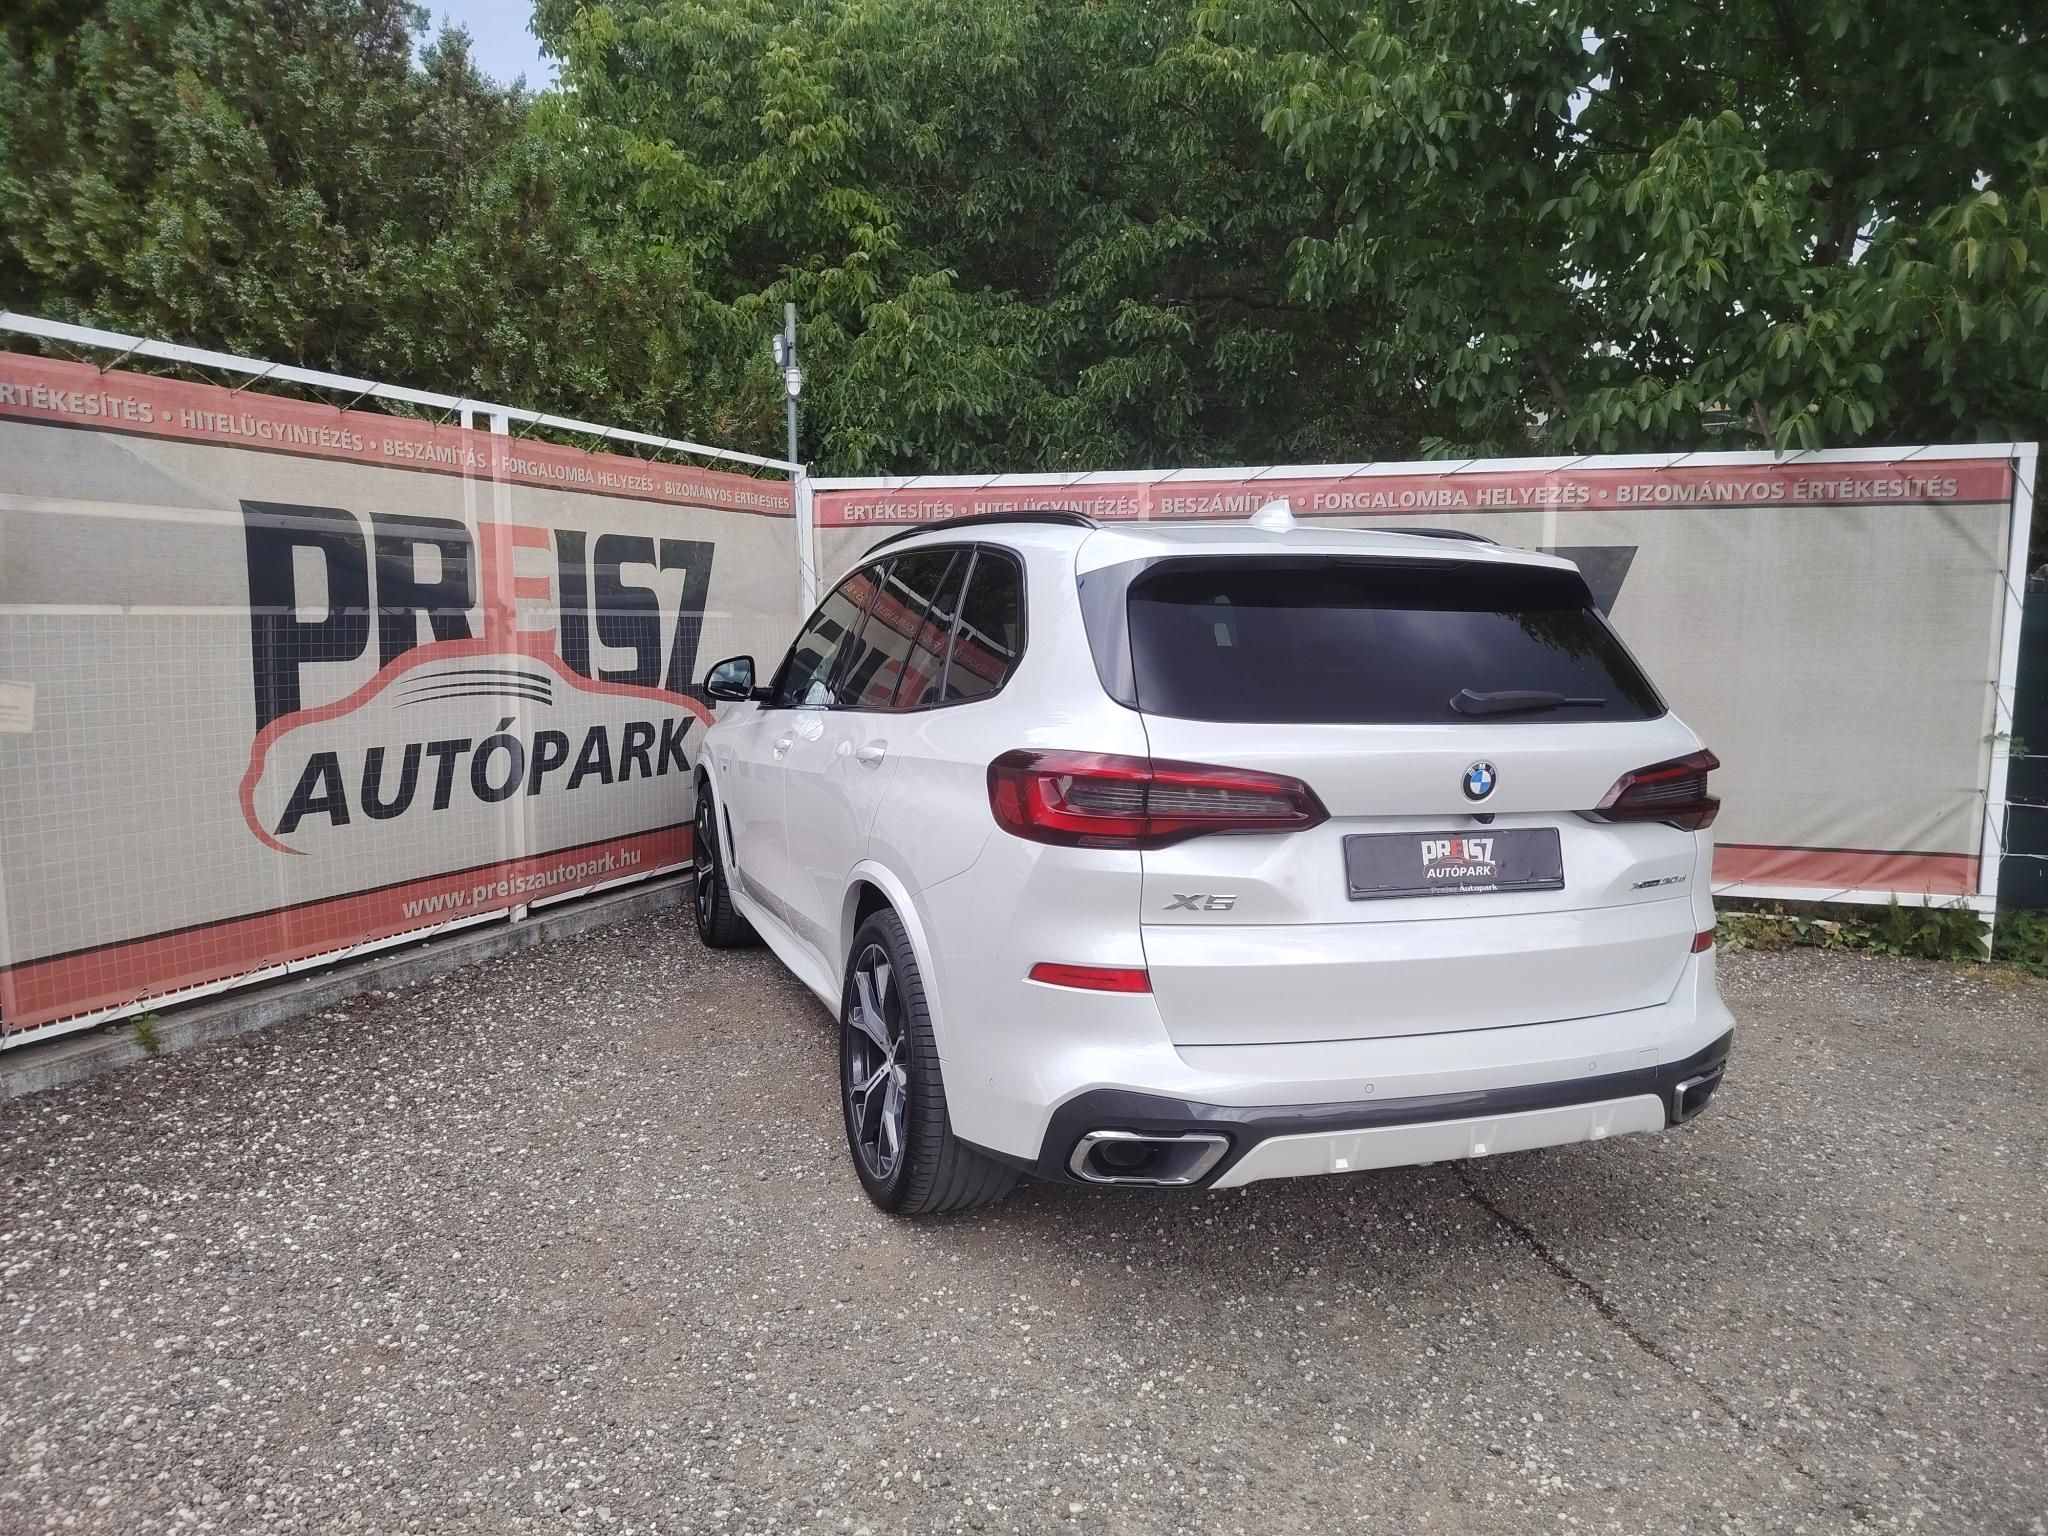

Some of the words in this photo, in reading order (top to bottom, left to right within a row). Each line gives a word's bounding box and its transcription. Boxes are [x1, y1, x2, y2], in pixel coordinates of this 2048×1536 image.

[180, 408, 364, 452] HITELÜGYINTÉZÉS
[383, 438, 487, 469] BESZÁMÍTÁS
[502, 455, 594, 484] FORGALOMBA
[598, 471, 654, 493] HELYEZÉS
[665, 482, 732, 503] BIZOMÁNYOS
[735, 489, 790, 510] ÉRTÉKESÍTÉS
[843, 499, 954, 521] ÉRTÉKESÍTÉS
[1313, 488, 1469, 510] FORGALOMBA
[1476, 484, 1591, 507] HELYEZÉS
[1616, 480, 1785, 503] BIZOMÁNYOS
[1793, 475, 1959, 499] ÉRTÉKESÍTÉS
[239, 500, 716, 735] PREISZ
[274, 716, 696, 836] AUTÓPARK
[402, 847, 641, 920] www.preiszautopark.hu
[1421, 837, 1496, 866] PREISZ
[1427, 864, 1491, 878] AUTÓPARK
